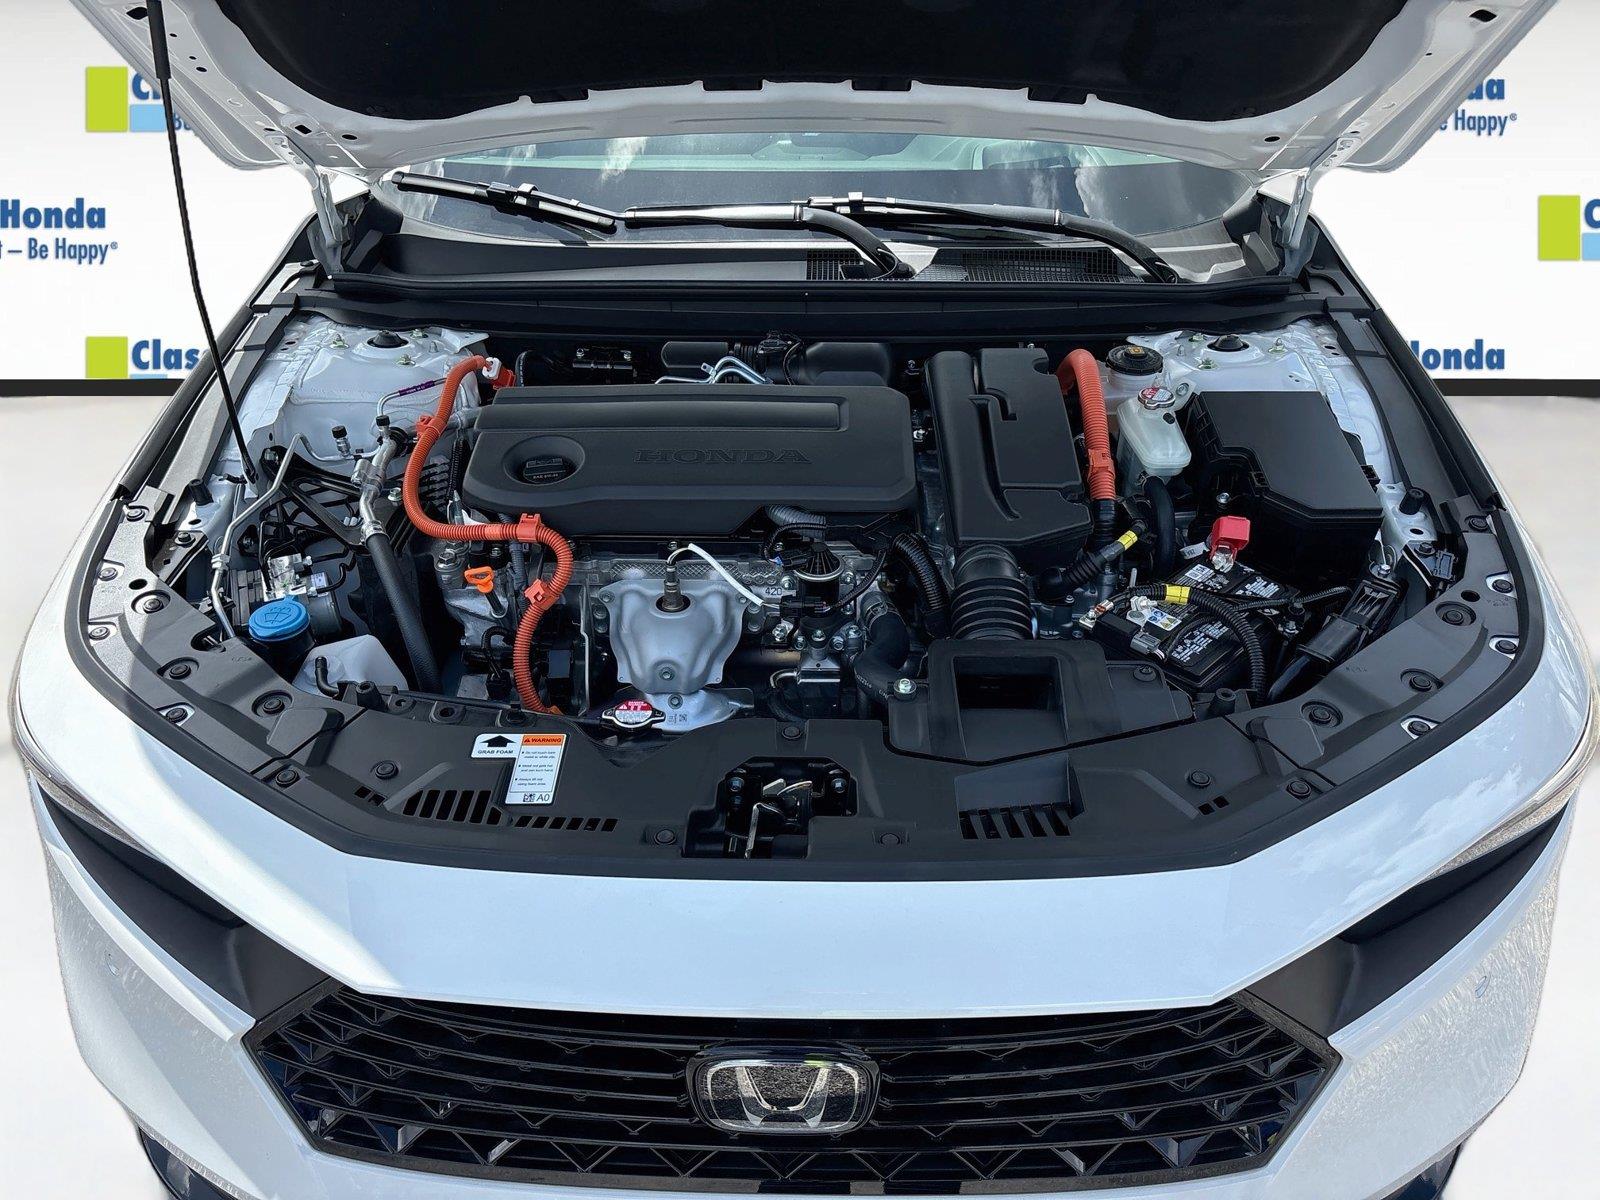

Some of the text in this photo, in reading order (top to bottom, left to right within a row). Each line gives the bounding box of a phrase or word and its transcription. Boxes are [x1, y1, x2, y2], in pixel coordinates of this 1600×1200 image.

[0, 197, 106, 229] Honda
[28, 237, 49, 260] Be
[633, 449, 812, 464] HONDA
